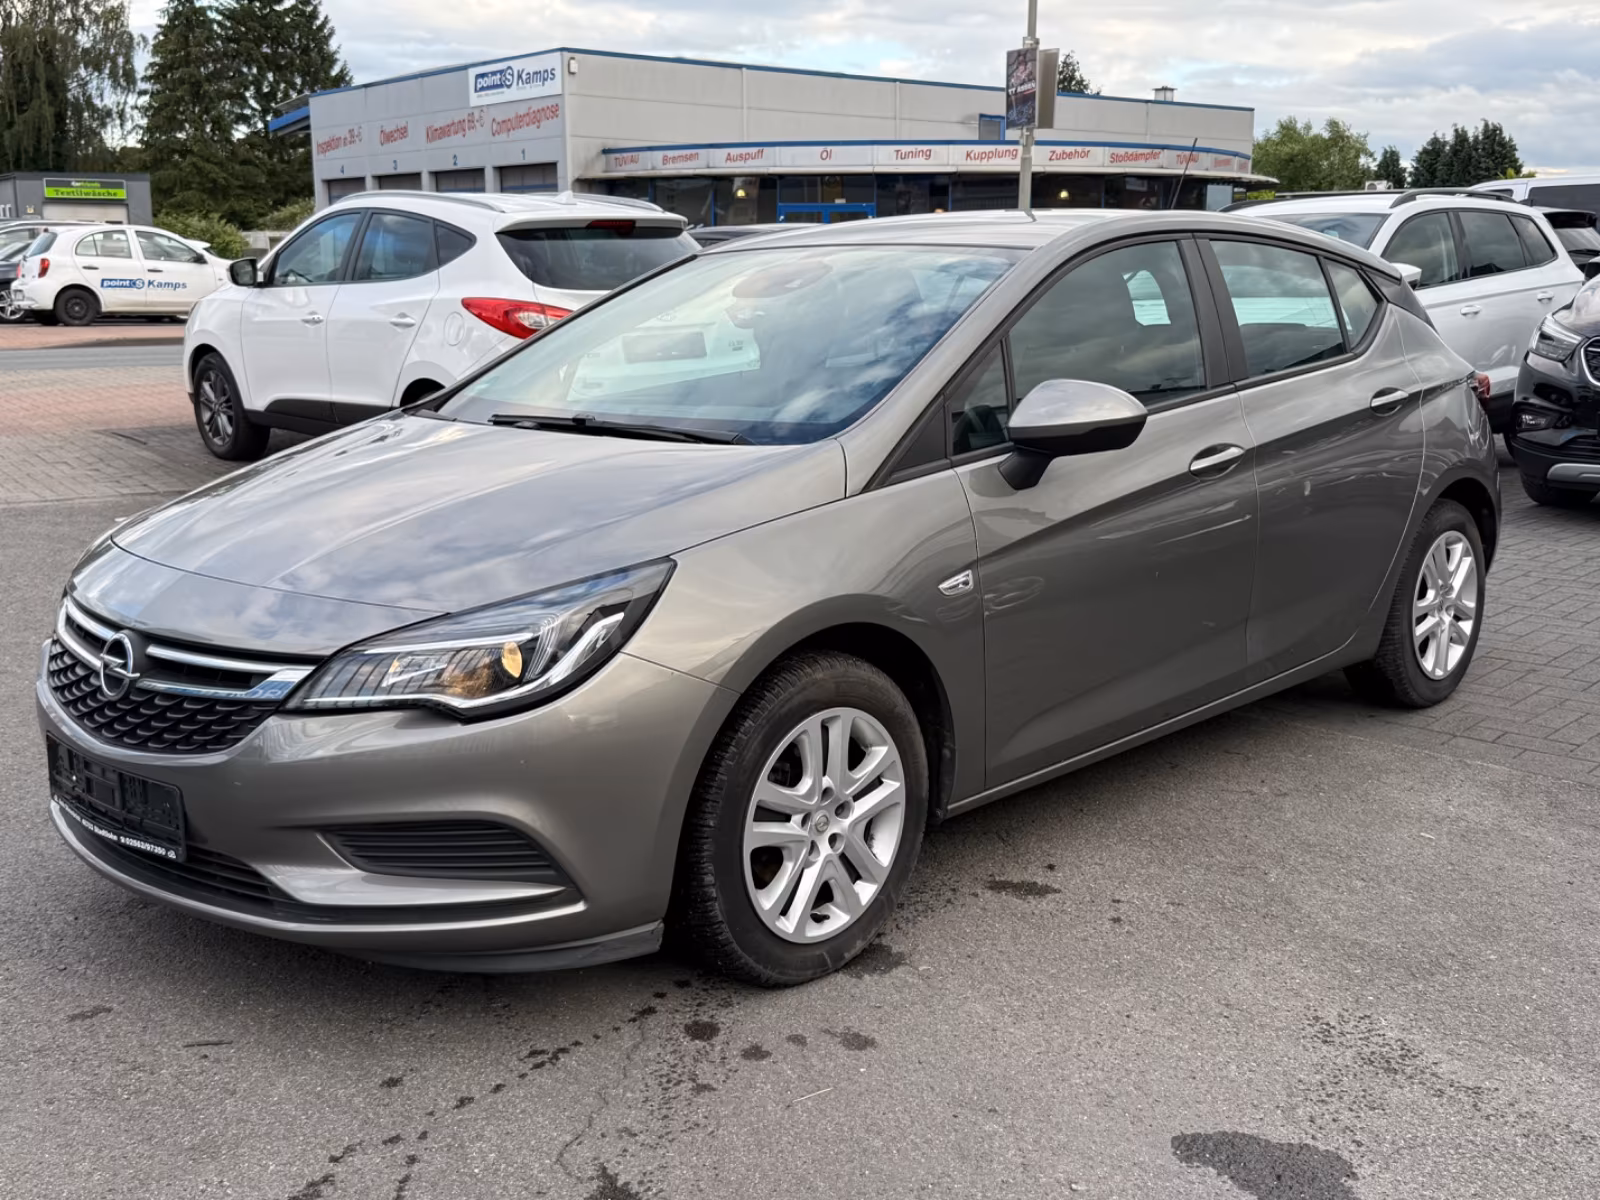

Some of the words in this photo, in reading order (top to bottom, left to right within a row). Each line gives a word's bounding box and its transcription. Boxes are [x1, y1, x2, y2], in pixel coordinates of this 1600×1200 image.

[476, 73, 501, 91] point
[516, 67, 556, 87] Kamps
[491, 103, 559, 138] Computerdiagnose
[426, 117, 467, 144] Klimawartung
[662, 151, 699, 166] Bremsen
[725, 148, 764, 164] Auspuff
[819, 149, 832, 161] Öl
[894, 147, 932, 162] Tuning
[965, 147, 1018, 163] Kupplung
[1049, 147, 1091, 161] Zubehör
[1109, 149, 1162, 164] Stoßdämpfer
[54, 188, 118, 197] Textilwäsche
[102, 279, 130, 288] point
[147, 279, 188, 291] Kamps
